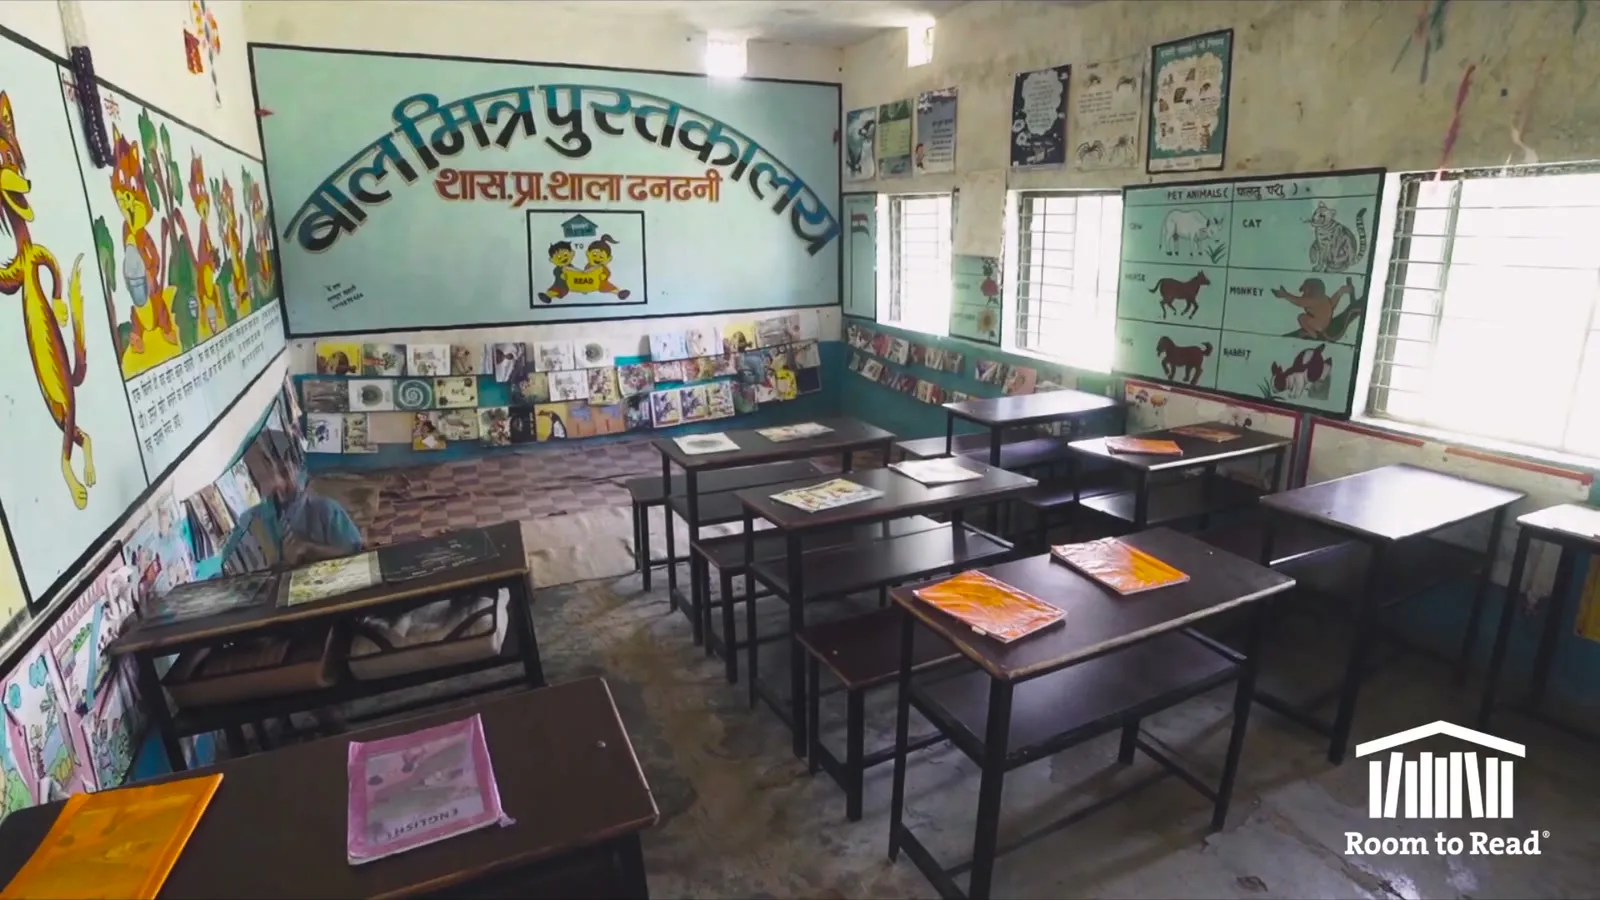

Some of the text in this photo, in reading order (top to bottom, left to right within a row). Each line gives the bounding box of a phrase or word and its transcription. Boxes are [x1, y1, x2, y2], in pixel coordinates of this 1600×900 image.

[283, 83, 841, 256] बाल मित्र पुस्तकालय
[1167, 190, 1183, 201] PET
[1242, 218, 1263, 228] CAT
[573, 275, 594, 285] READ
[1229, 285, 1265, 297] MONKEY
[1223, 346, 1252, 361] RABBIT
